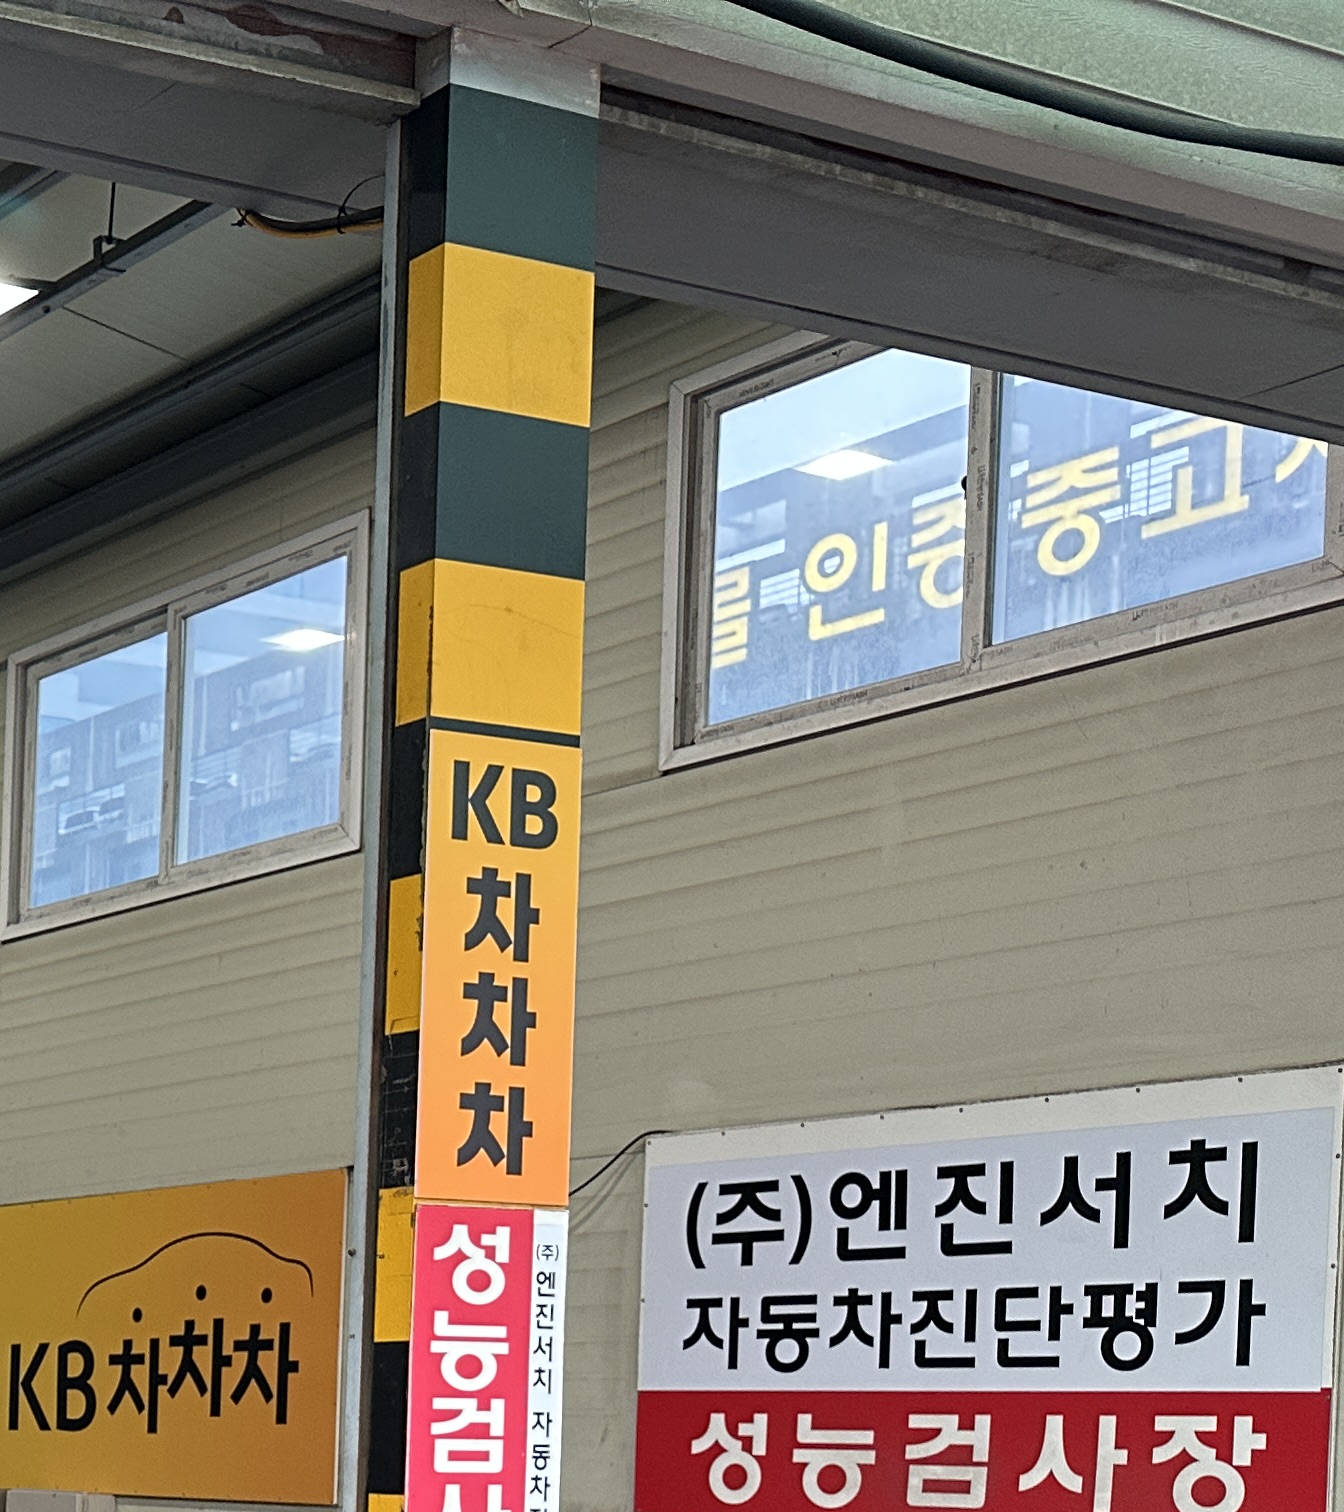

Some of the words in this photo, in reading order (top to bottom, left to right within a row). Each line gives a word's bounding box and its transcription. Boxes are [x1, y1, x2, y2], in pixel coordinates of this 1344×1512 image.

[450, 759, 559, 850] KB
[456, 866, 541, 1177] 차차차
[682, 1278, 1267, 1374] 자동차진단평가
